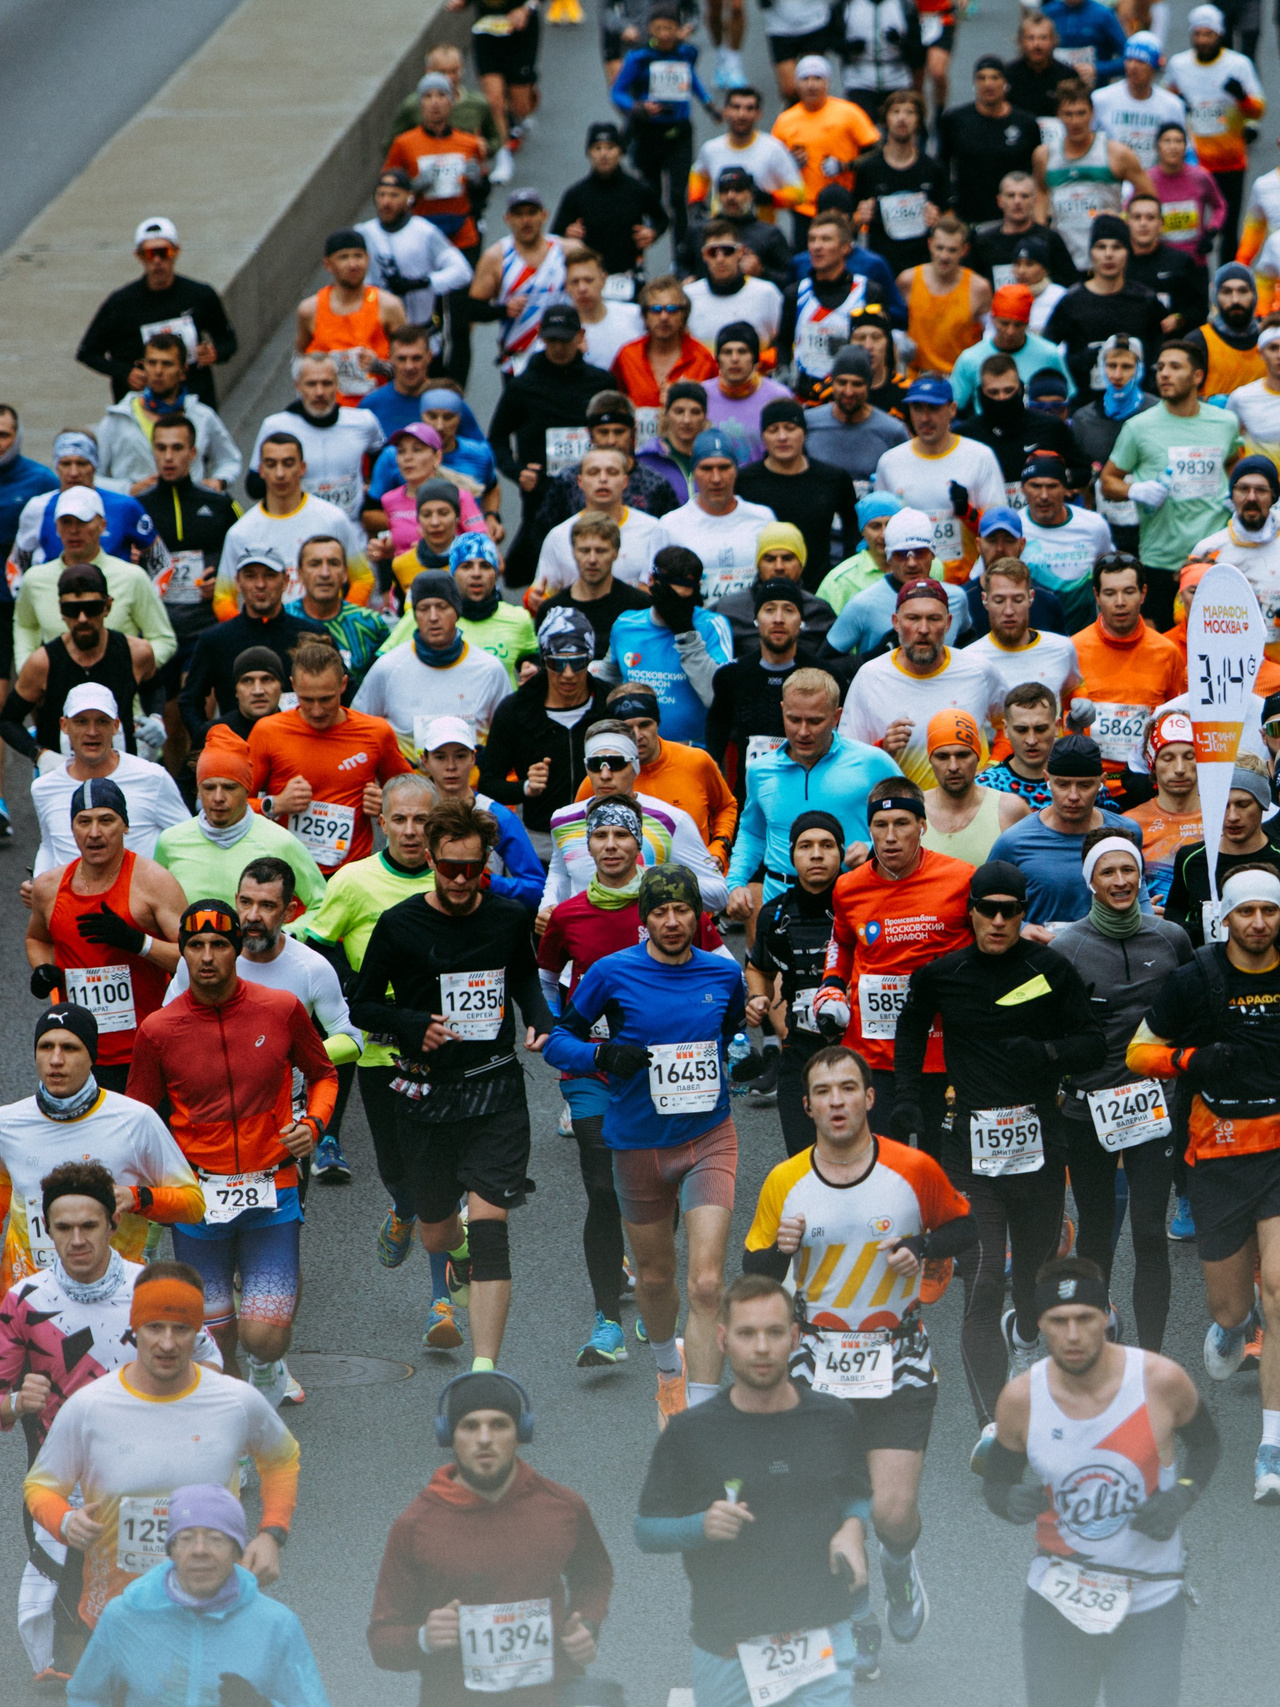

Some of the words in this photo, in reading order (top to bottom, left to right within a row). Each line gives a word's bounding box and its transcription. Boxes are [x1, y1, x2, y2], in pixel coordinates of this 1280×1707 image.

[1176, 459, 1216, 475] 9839
[1203, 605, 1248, 619] МАРАФОН
[1203, 620, 1243, 634] МОСКВА
[627, 669, 687, 681] МОСКОВСКИЙ
[1197, 653, 1245, 706] 3:14
[1099, 717, 1144, 738] 5862
[291, 813, 351, 841] 12592
[884, 914, 938, 926] Промсвязьбанк
[884, 922, 945, 935] МОСКОВСКИЙ
[886, 931, 929, 943] МАРАФОН
[68, 982, 130, 1006] 11100
[445, 987, 505, 1012] 12356
[867, 992, 911, 1012] 585
[466, 1012, 494, 1020] СЕРГЕЙ
[652, 1060, 719, 1085] 16453
[676, 1083, 701, 1092] ПАВЕЛ
[658, 1096, 669, 1109] C
[1095, 1089, 1164, 1124] 12402
[1115, 1114, 1149, 1128] ВАЛЕРИЙ
[974, 1122, 1040, 1149] 15959
[1105, 1133, 1116, 1146] C
[991, 1146, 1025, 1157] ДМИТРИЙ
[979, 1158, 989, 1171] C
[216, 1187, 260, 1208] 728
[811, 1227, 825, 1238] GRi
[825, 1350, 881, 1373] 4697
[1053, 1579, 1118, 1612] 7438
[465, 1621, 550, 1655] 11394
[761, 1635, 809, 1671] 257
